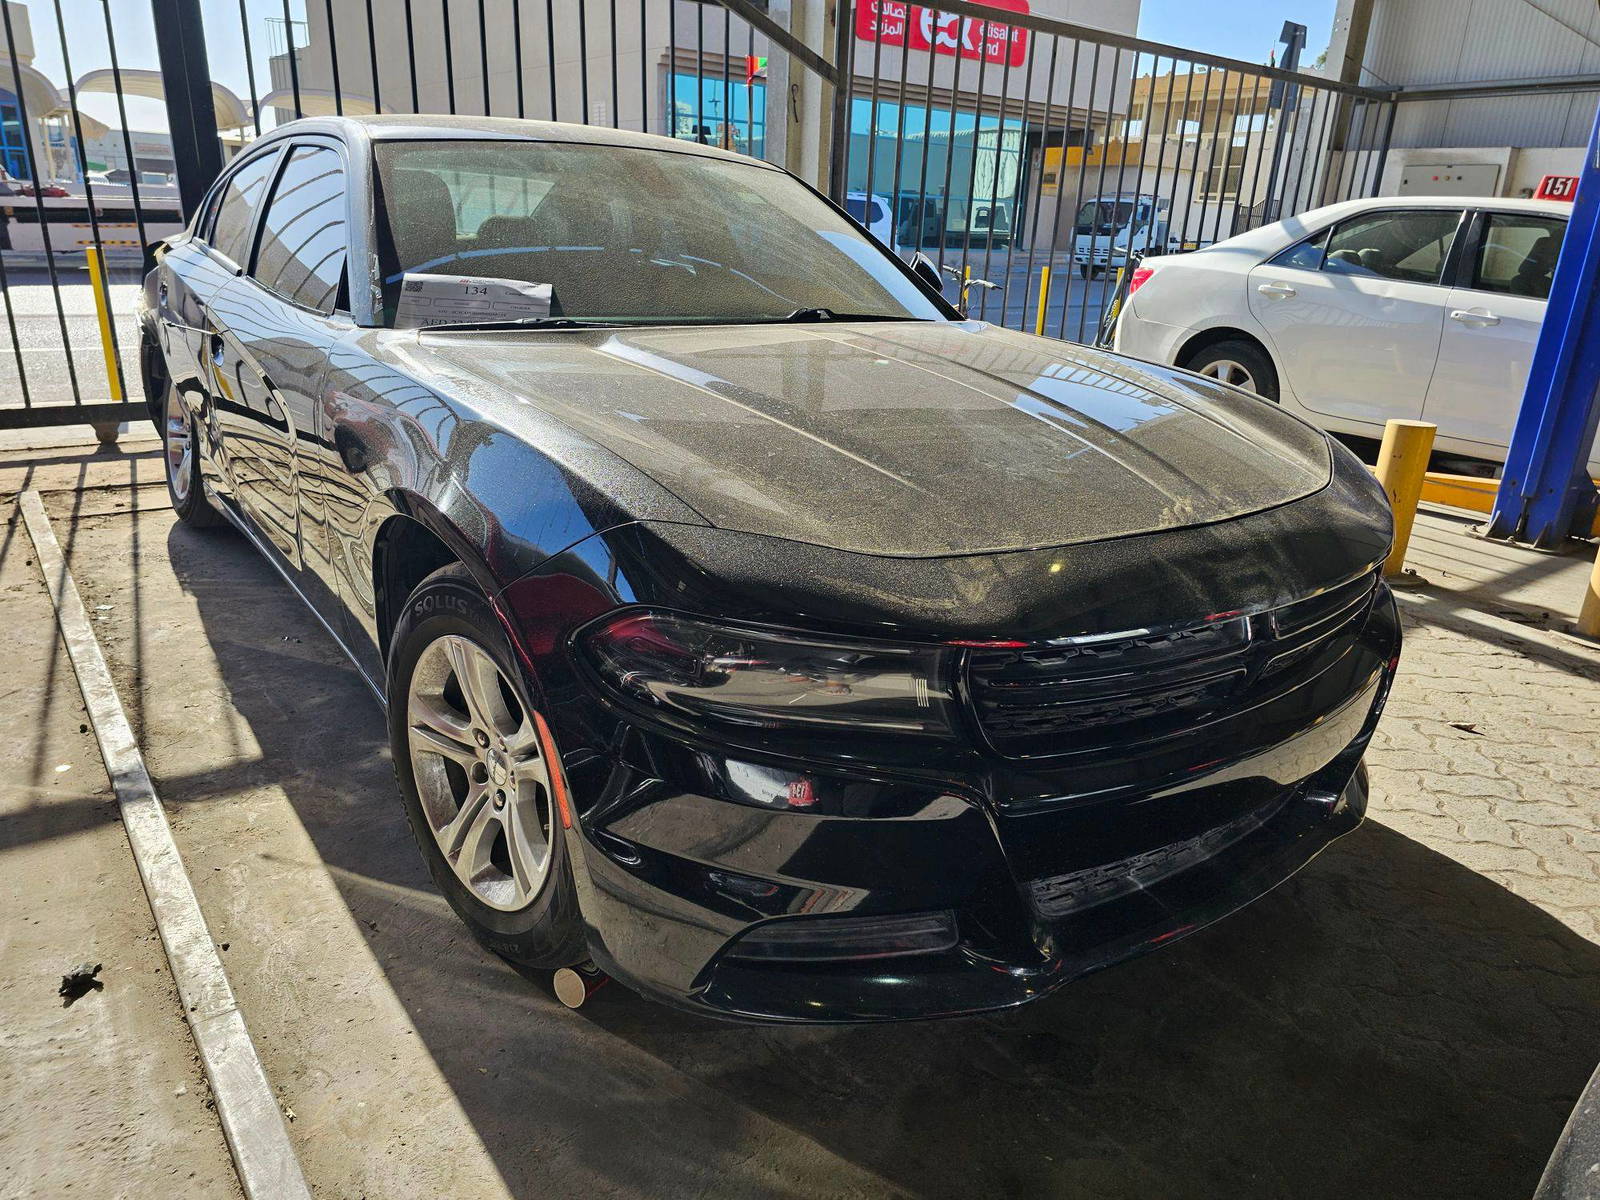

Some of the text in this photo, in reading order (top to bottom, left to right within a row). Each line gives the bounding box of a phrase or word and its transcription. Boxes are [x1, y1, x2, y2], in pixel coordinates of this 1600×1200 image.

[979, 23, 1018, 43] etisalt
[1544, 177, 1574, 196] 151
[464, 286, 488, 296] 134
[414, 594, 467, 616] SOLUS
